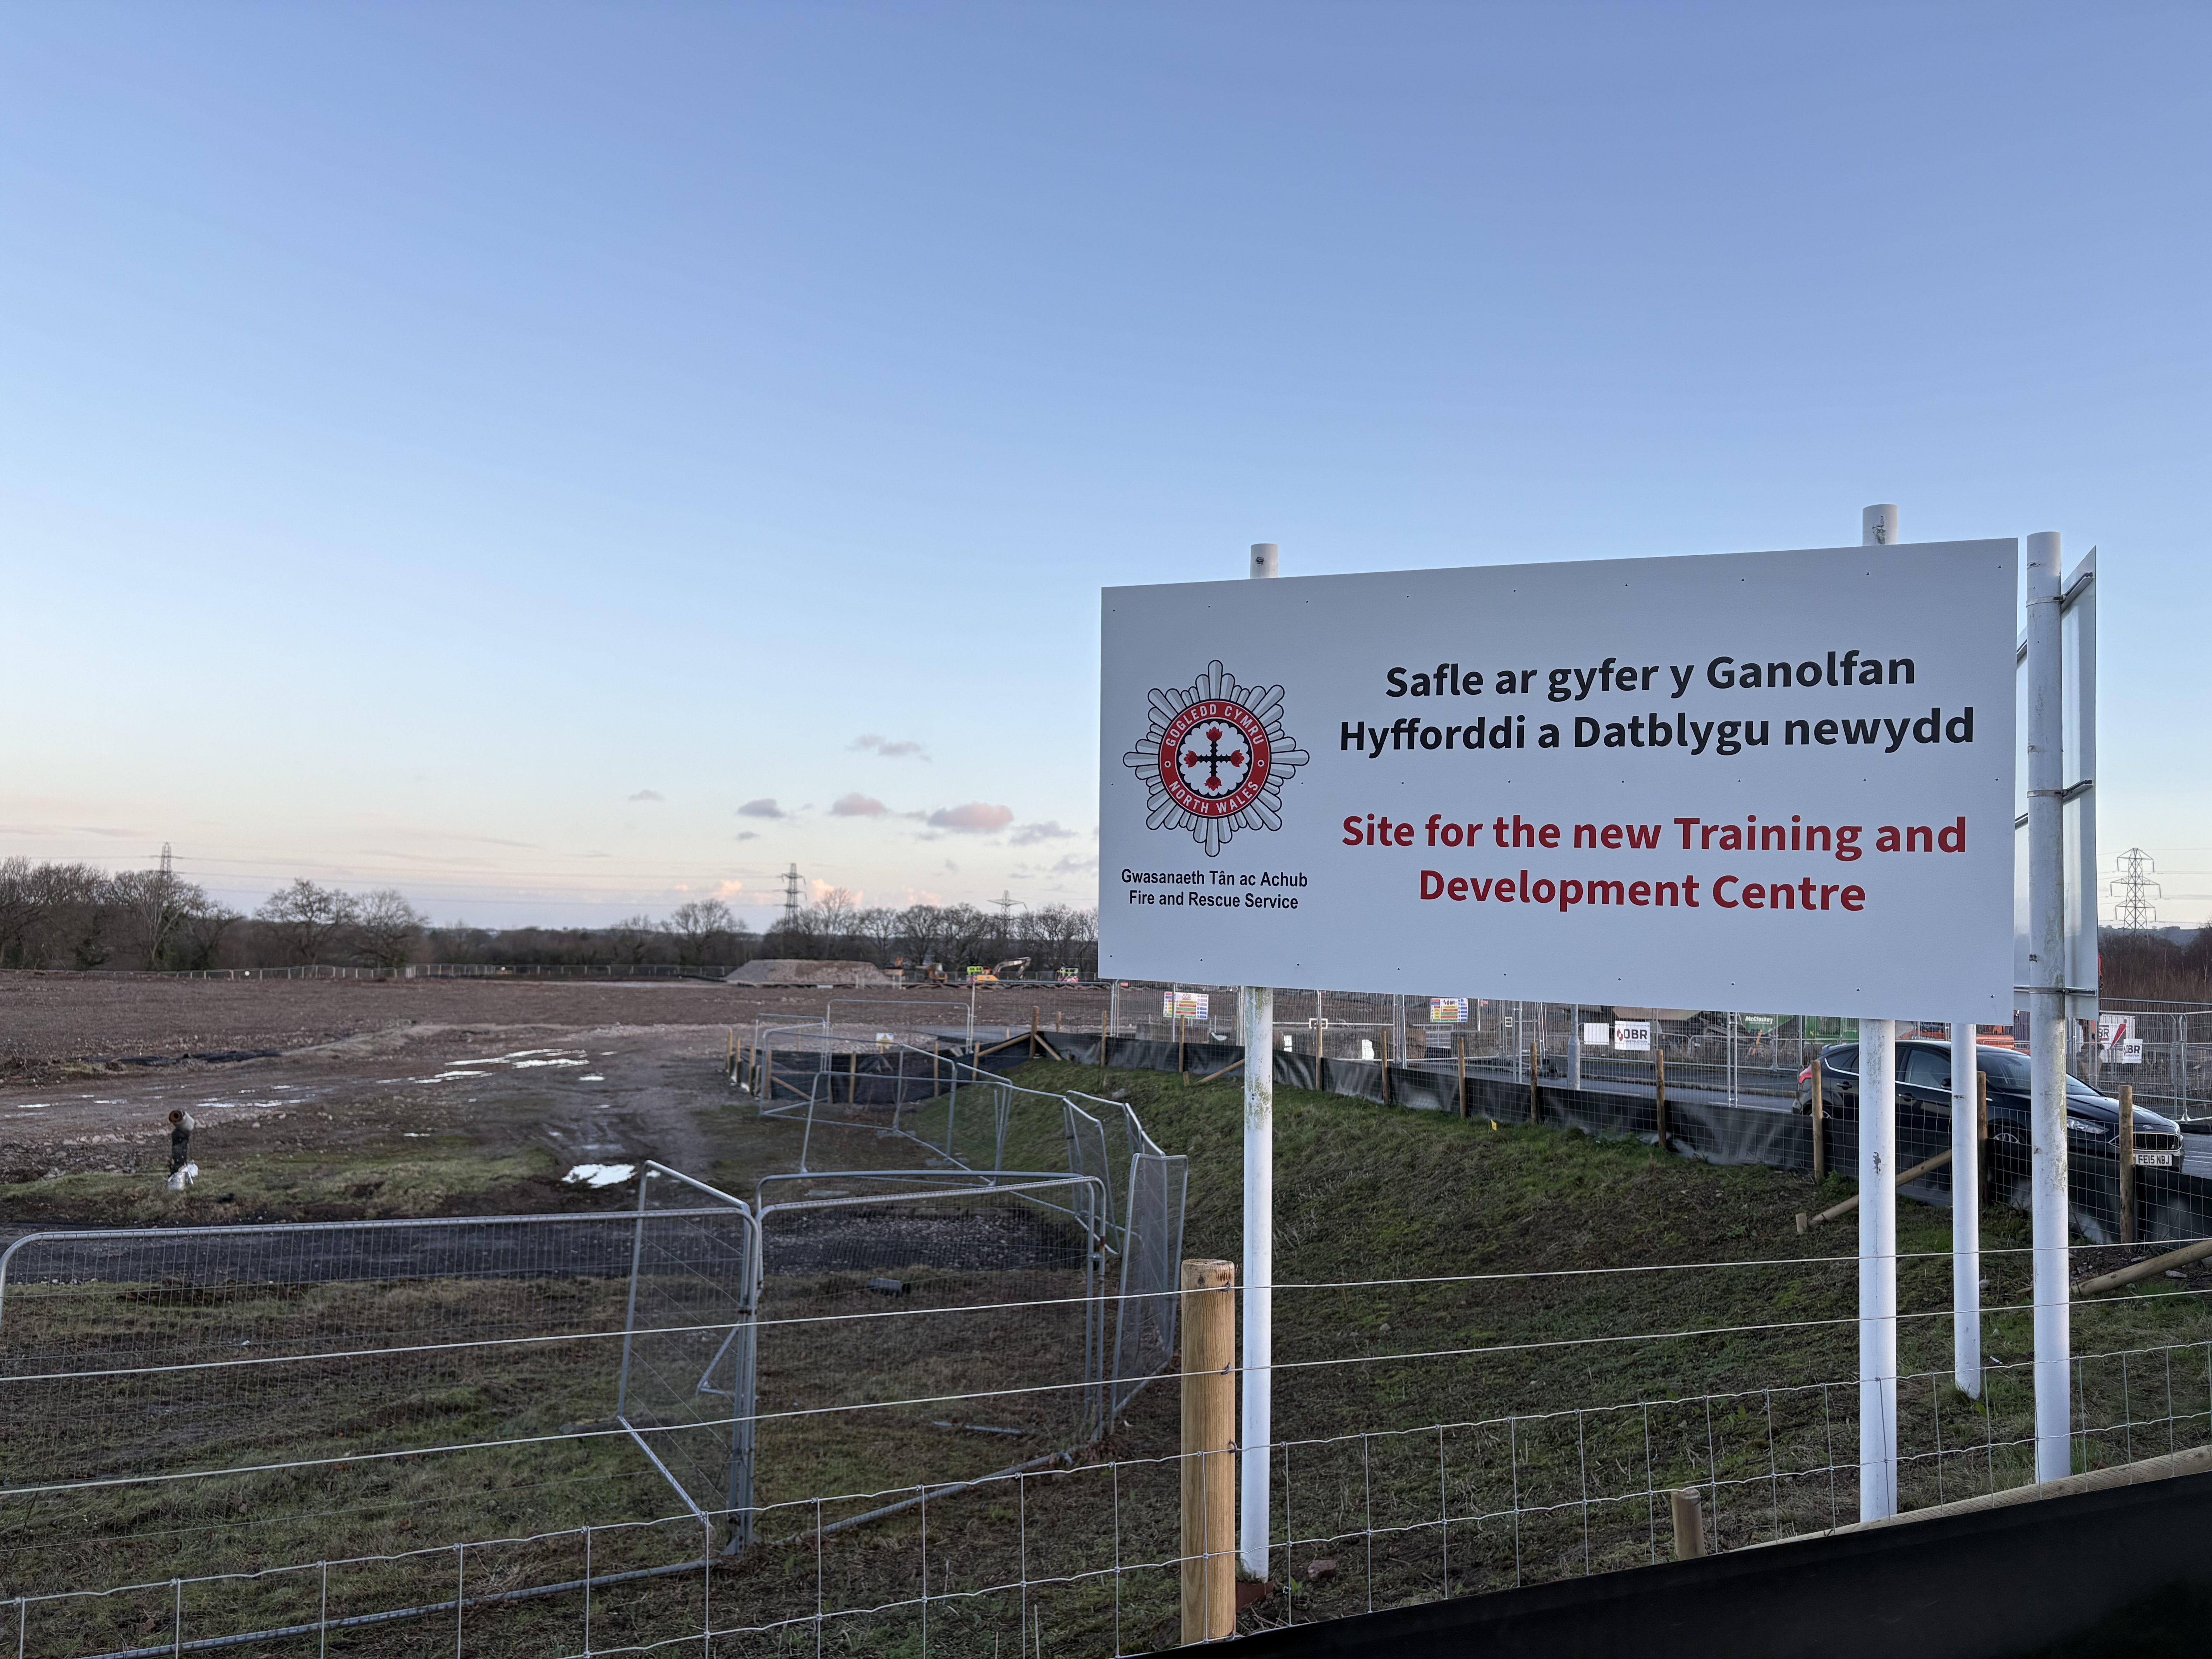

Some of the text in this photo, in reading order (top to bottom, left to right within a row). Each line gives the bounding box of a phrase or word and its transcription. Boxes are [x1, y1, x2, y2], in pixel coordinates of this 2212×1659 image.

[1385, 649, 1915, 702] Safle ar gyfer y Ganolfan
[1165, 704, 1264, 747] GOGLEDD CYMRU
[1340, 706, 1974, 759] Hyfforddi a Datblygu newydd
[1169, 780, 1259, 814] NORTH WALES
[1342, 813, 1966, 862] Site for the new Training and
[1121, 868, 1308, 888] Gwasanaeth Tân ac Achub
[1420, 869, 1866, 913] Development Centre
[1129, 890, 1298, 909] Fire and Rescue Service
[1623, 1029, 1647, 1040] OBR
[1745, 1015, 1773, 1025] McCloskey
[2138, 1155, 2170, 1164] FE15 NBJ
